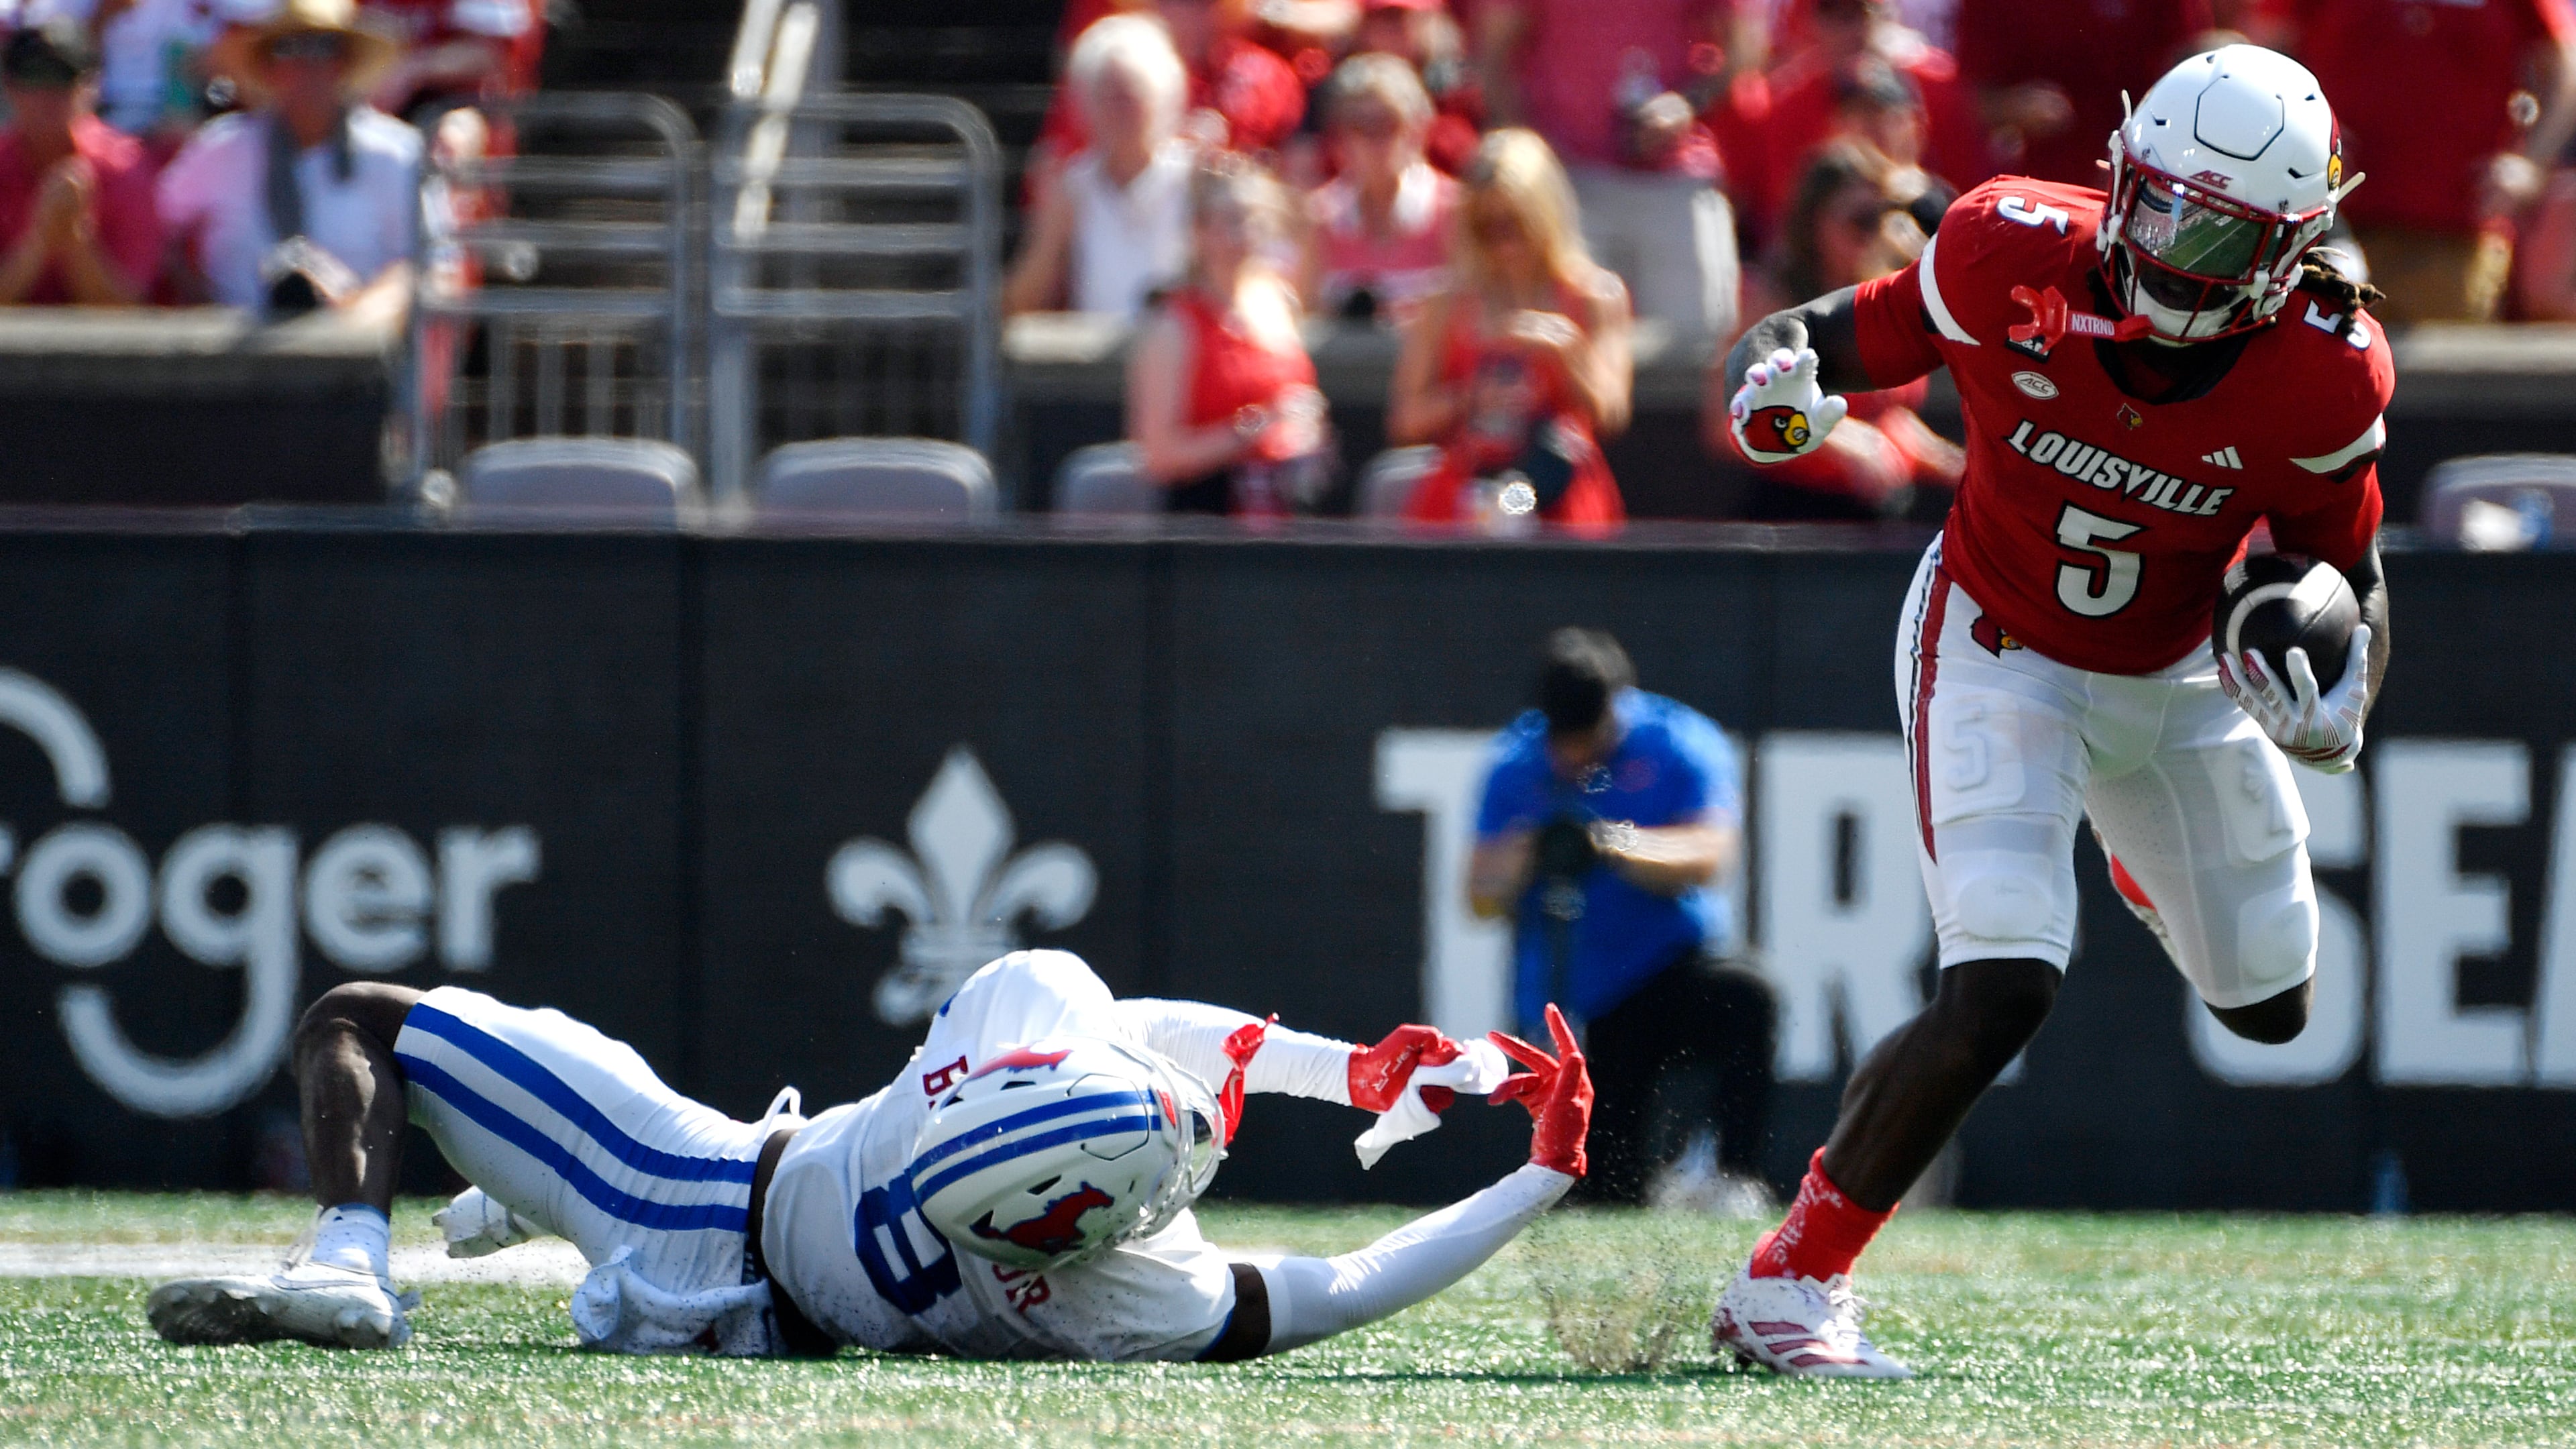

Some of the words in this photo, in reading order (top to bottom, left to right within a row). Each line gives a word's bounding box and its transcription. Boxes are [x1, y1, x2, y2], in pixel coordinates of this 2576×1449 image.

[1998, 196, 2068, 236] 5
[2189, 170, 2233, 190] ACC
[2072, 313, 2114, 335] NXTRND
[2303, 299, 2371, 350] 5
[2020, 378, 2050, 393] ACC
[2006, 419, 2233, 516] LOUISVILLE
[2055, 501, 2147, 618] 5
[2186, 737, 2576, 1088] SE
[0, 820, 542, 1119] oger
[855, 1169, 963, 1316] 8
